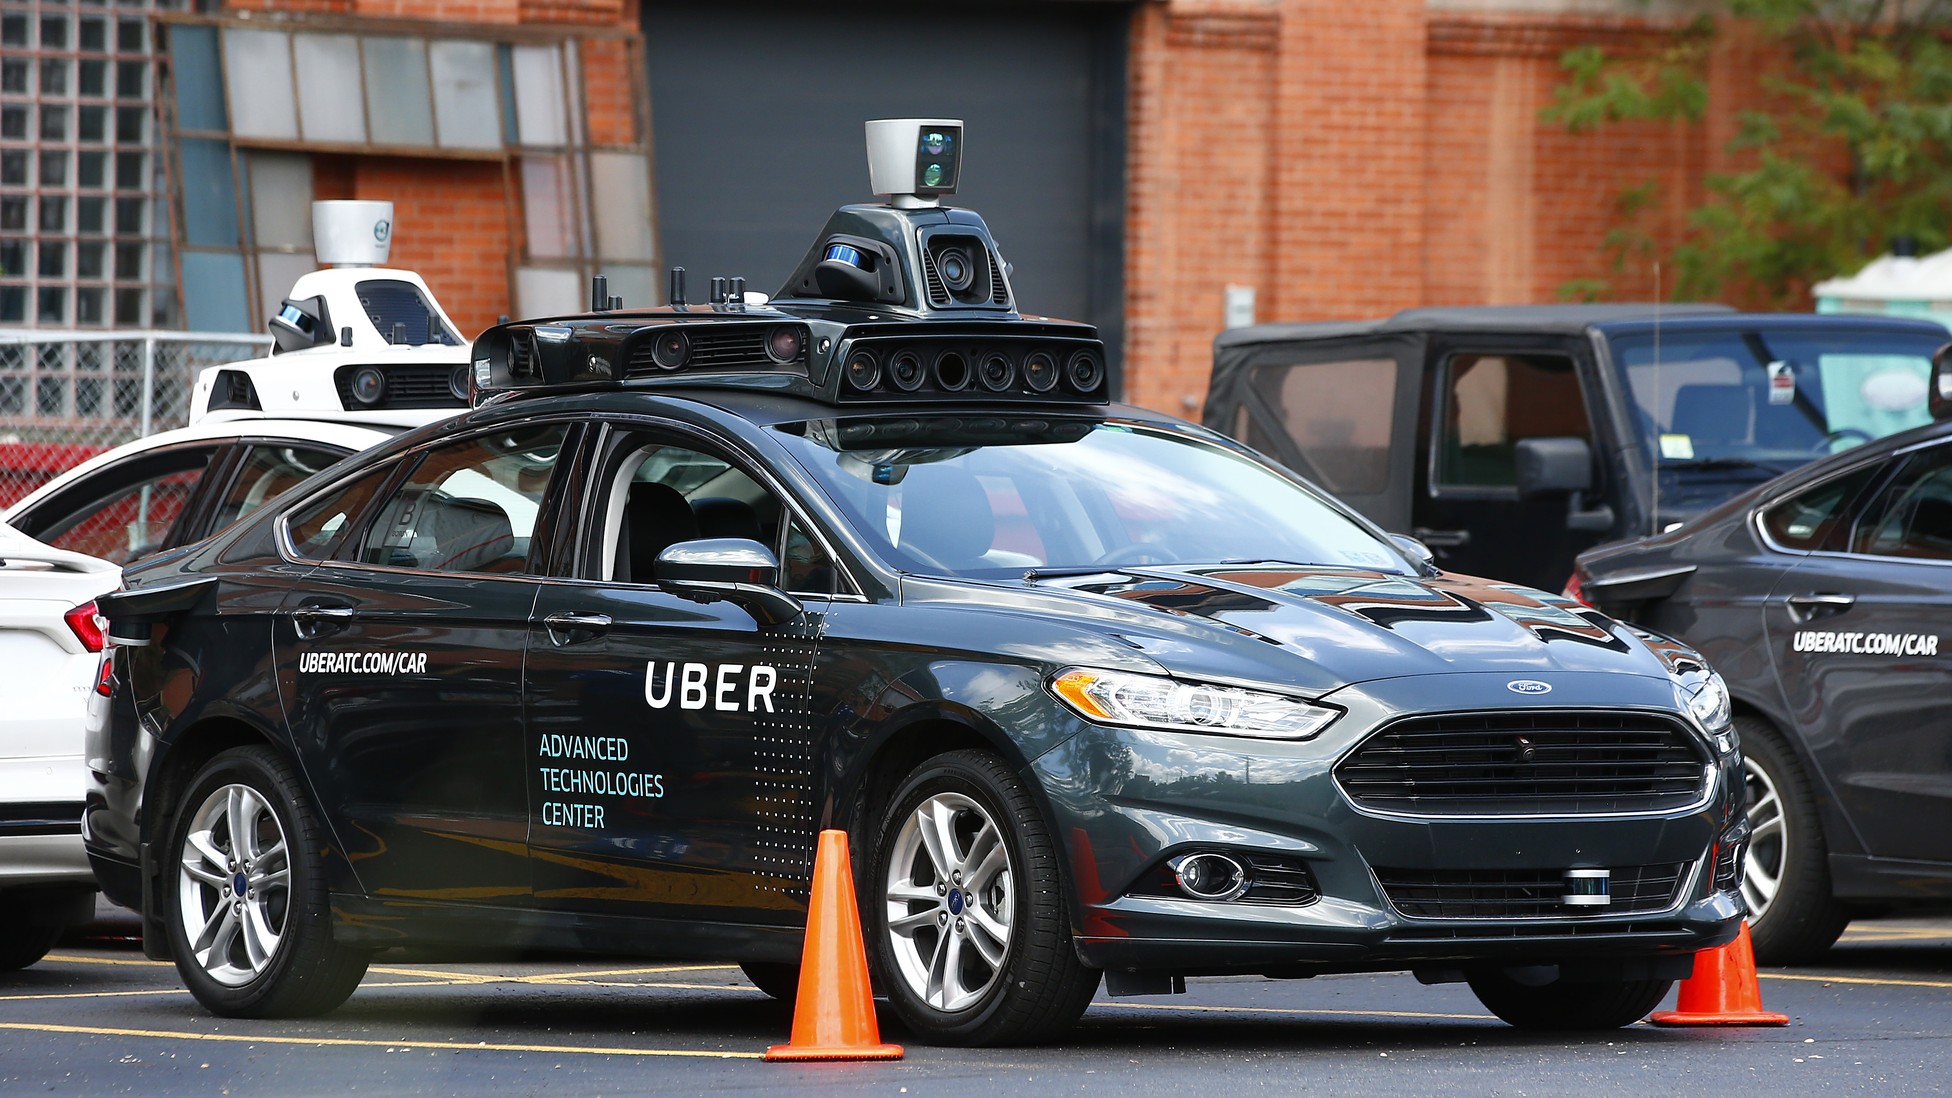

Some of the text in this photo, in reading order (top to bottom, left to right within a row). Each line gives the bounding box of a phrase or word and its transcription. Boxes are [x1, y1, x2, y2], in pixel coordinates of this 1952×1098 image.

[1793, 631, 1938, 657] UBERATC.COM/CAR
[299, 652, 427, 676] UBERATC.COM/CAR
[644, 661, 777, 713] UBER
[539, 734, 628, 761] ADVANCED
[540, 767, 664, 798] TECHNOLOGIES
[542, 802, 605, 829] CENTER
